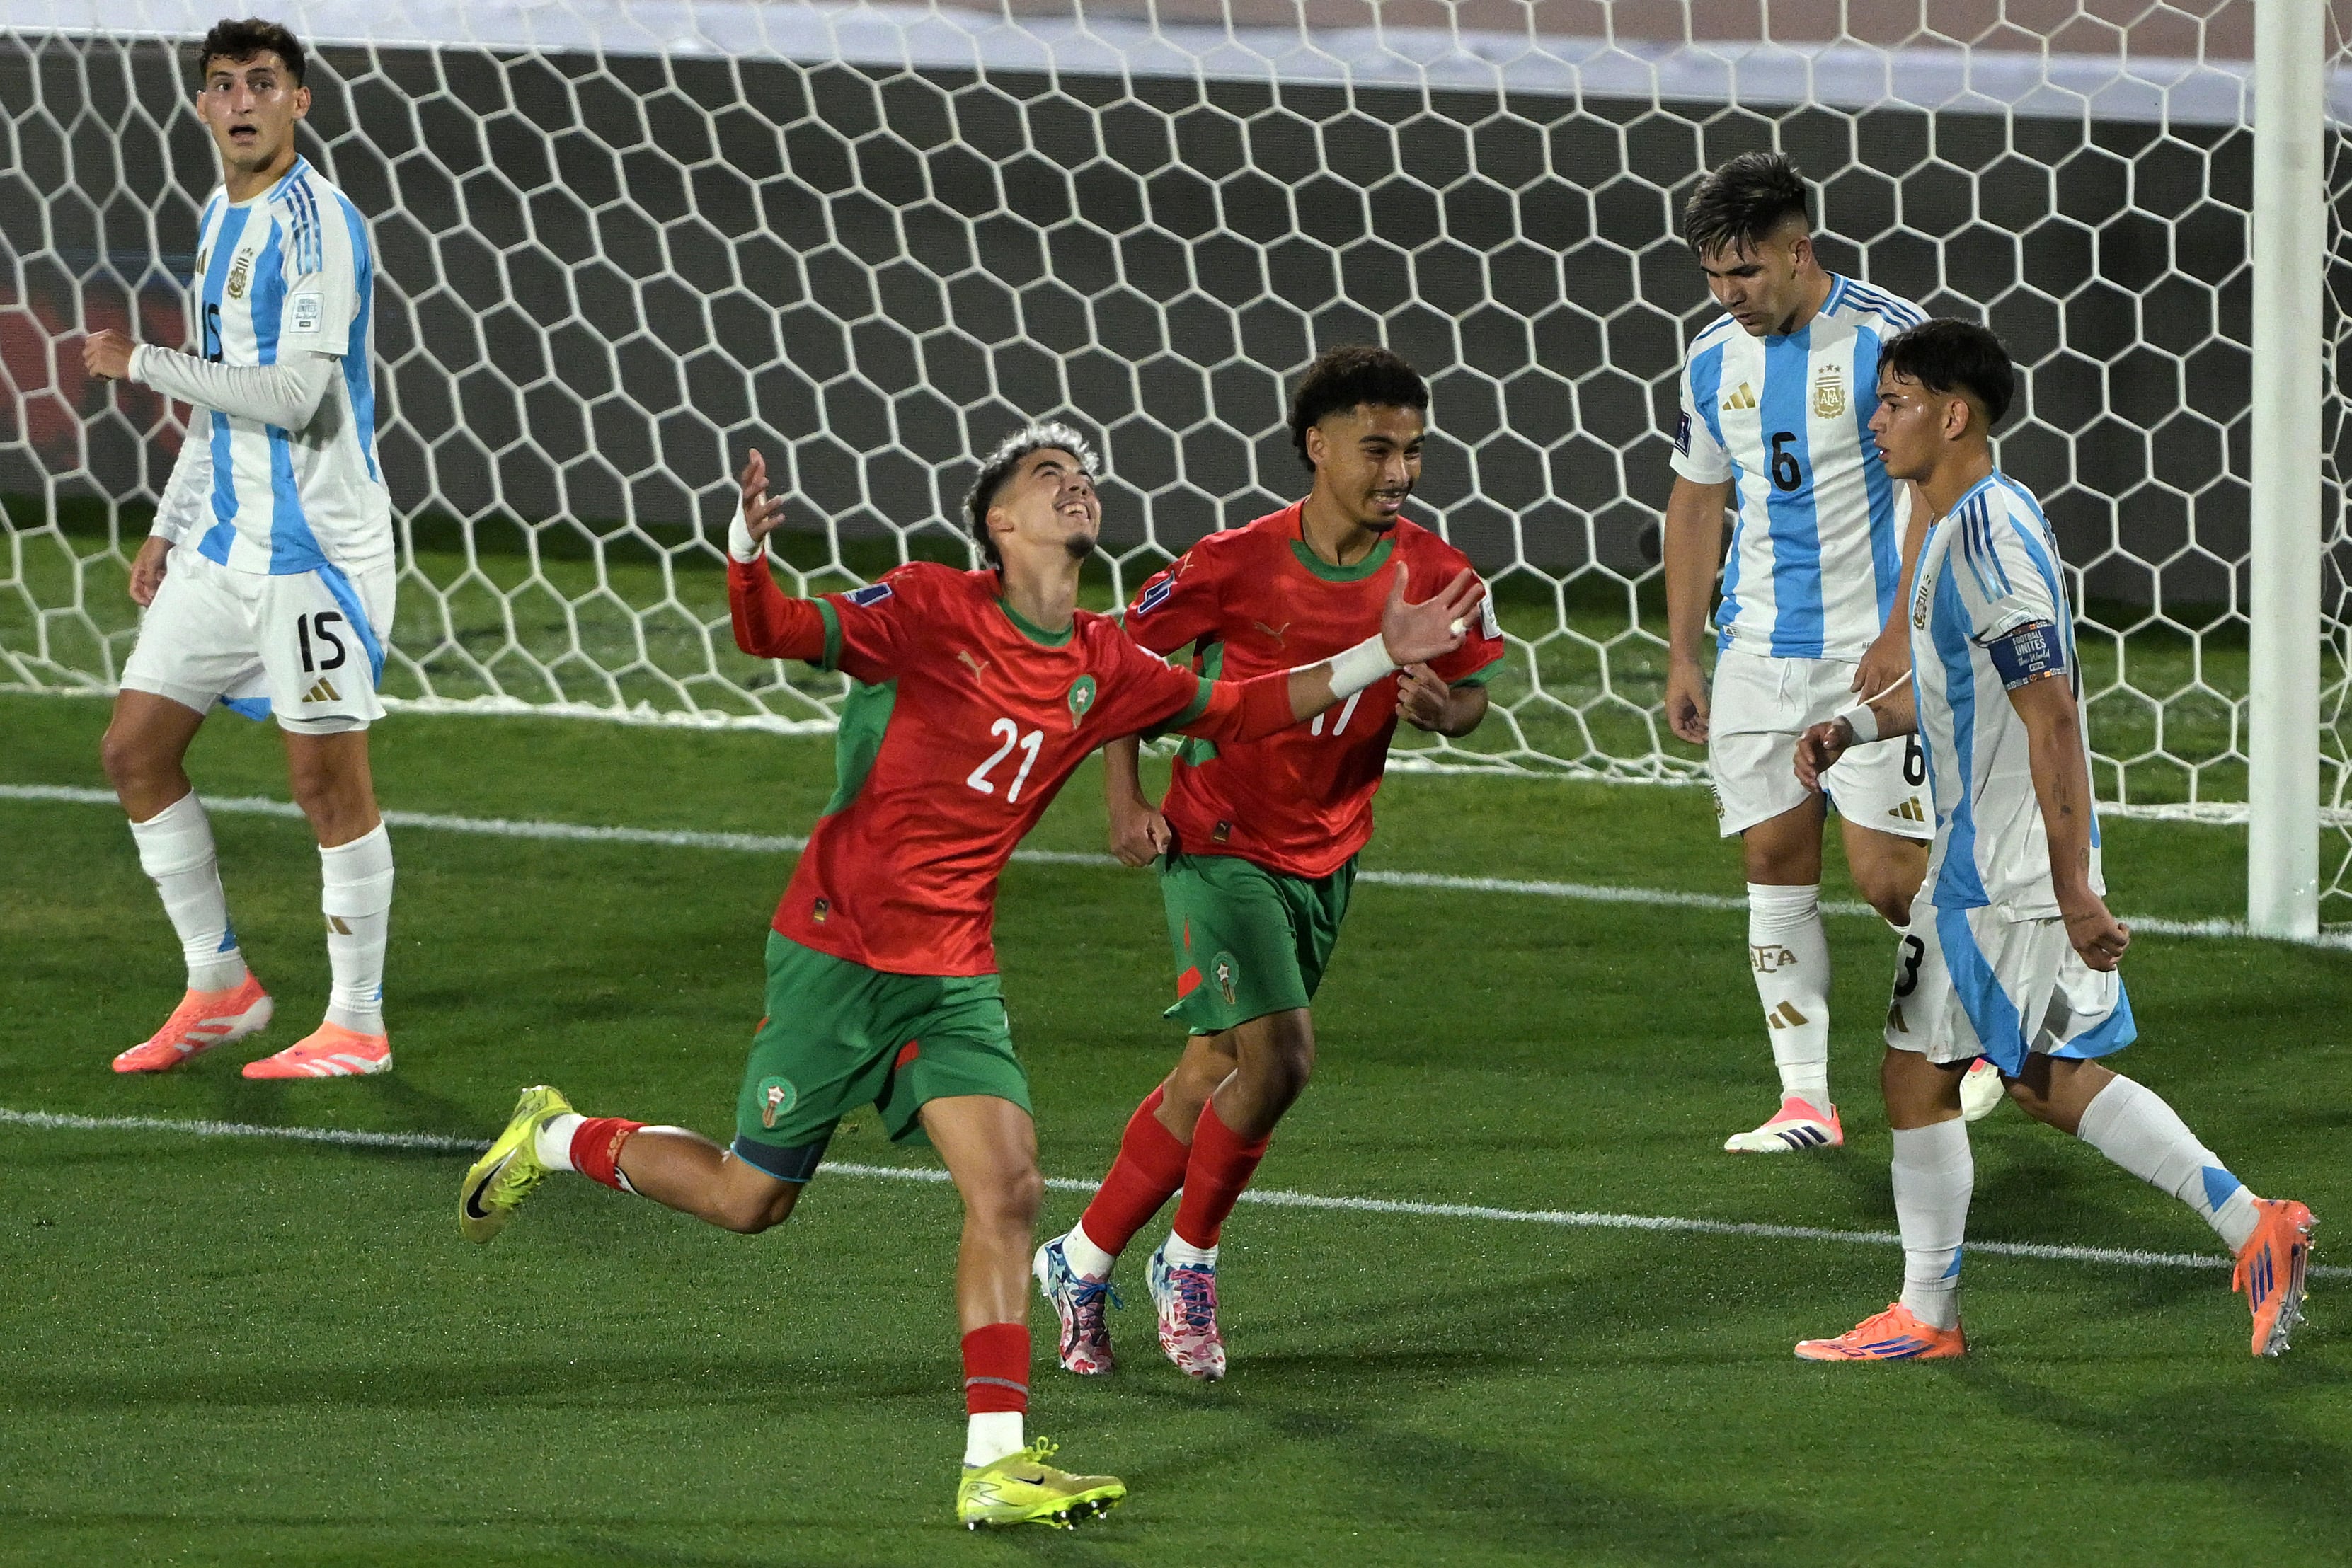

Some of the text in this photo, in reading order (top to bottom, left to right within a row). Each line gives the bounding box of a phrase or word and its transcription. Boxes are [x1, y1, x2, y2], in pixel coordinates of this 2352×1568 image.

[1820, 387, 1839, 407] AFA
[1772, 431, 1802, 492] 6
[297, 611, 346, 672] 15
[2012, 630, 2043, 645] FOOTBALL
[2014, 638, 2047, 656] UNITES
[967, 717, 1044, 803] 21
[1903, 732, 1926, 787] 6
